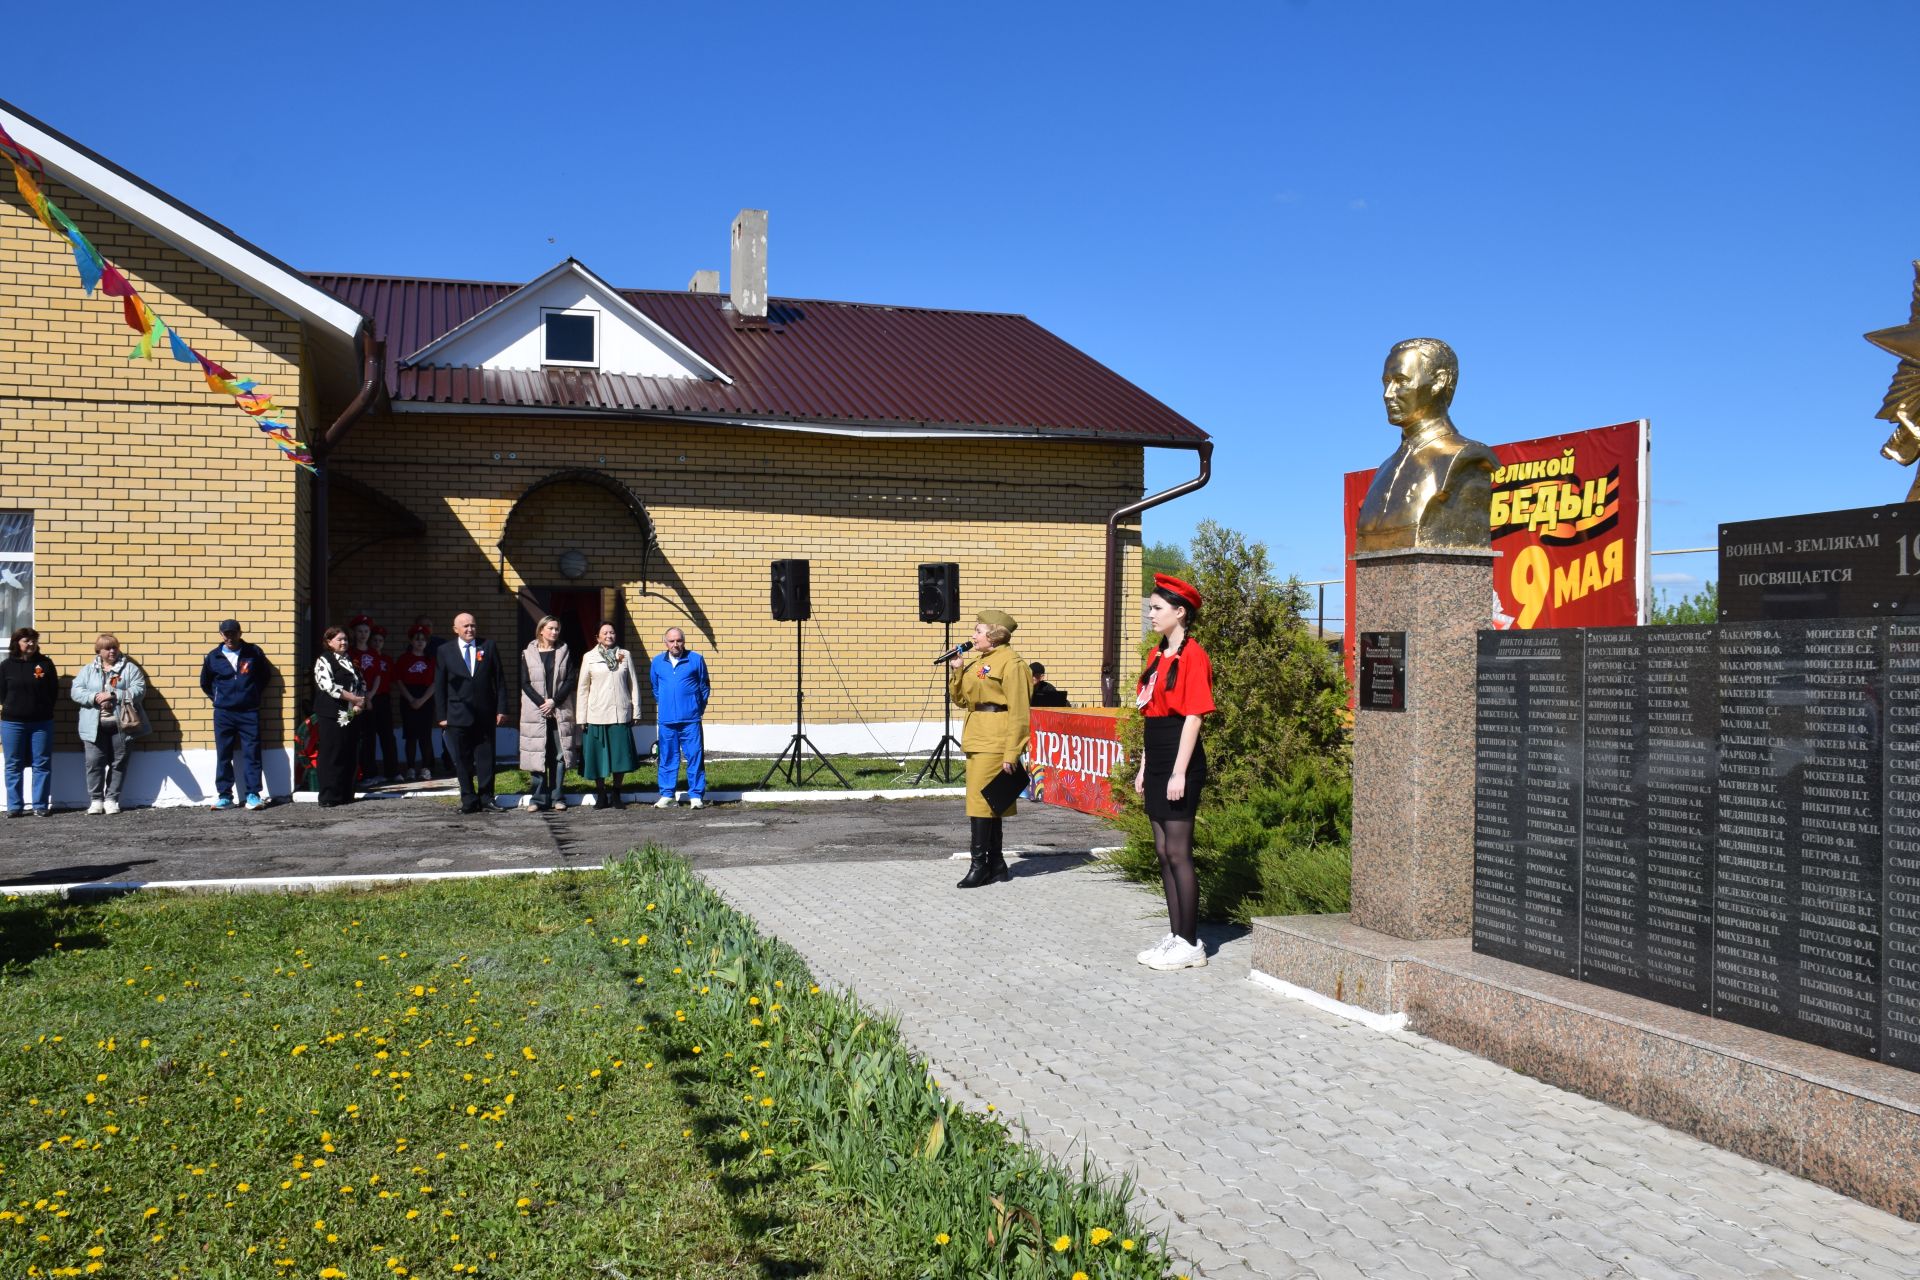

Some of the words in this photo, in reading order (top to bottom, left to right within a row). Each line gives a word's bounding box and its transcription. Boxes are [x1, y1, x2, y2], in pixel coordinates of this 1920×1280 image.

[1491, 448, 1575, 483] еликой
[1490, 477, 1608, 533] БЕДЫ!
[1726, 541, 1784, 557] ВОИНАМ
[1796, 534, 1880, 553] ЗЕМЛЯКАМ
[1510, 545, 1550, 629] 9
[1554, 539, 1623, 609] МАЯ
[1739, 569, 1852, 586] ПОСВЯЩАЕТСЯ
[1720, 631, 1761, 640] МАКАРОВ
[1806, 630, 1854, 638] МОИСЕЕВ
[1720, 646, 1761, 654] МАКАРОВ
[1806, 645, 1853, 653] МОИСЕЕВ
[1856, 645, 1874, 654] С.Е.
[1720, 662, 1761, 670] МАКАРОВ
[1764, 662, 1784, 670] М.М.
[1805, 660, 1853, 669] МОИСЕЕВ
[1649, 674, 1672, 682] КЛЕЕВ
[1720, 676, 1761, 684] МАКАРОВ
[1805, 675, 1846, 684] МОКЕЕВ
[1849, 676, 1867, 684] Г.М.
[1720, 690, 1755, 698] МАКЕЕВ
[1806, 690, 1846, 699] МОКЕЕВ
[1720, 706, 1763, 714] МАЛИКОВ
[1766, 707, 1781, 715] С.Г.
[1805, 706, 1846, 715] МОКЕЕВ
[1649, 726, 1678, 734] КОЗЛОВ
[1720, 720, 1752, 728] МАЛОВ
[1805, 722, 1845, 732] МОКЕЕВ
[1720, 735, 1766, 745] МАЛЫГИН
[1805, 739, 1845, 749] МОКЕЕВ
[1848, 740, 1868, 751] М.В.
[1035, 731, 1124, 783] ПРАЗДНИ
[1720, 750, 1756, 760] МАРКОВ
[1720, 764, 1760, 774] МАТВЕЕВ
[1804, 756, 1845, 766] МОКЕЕВ
[1848, 758, 1868, 769] М.Д.
[1804, 771, 1844, 782] МОКЕЕВ
[1719, 780, 1758, 791] МАТВЕЕВ
[1761, 783, 1777, 793] М.Г.
[1803, 787, 1849, 799] МОШКОВ
[1648, 795, 1687, 806] КУЗНЕЦОВ
[1719, 795, 1767, 807] МЕДЯНЦЕВ
[1769, 801, 1786, 809] А.С.
[1649, 808, 1687, 819] КУЗНЕЦОВ
[1802, 803, 1851, 815] НИКИТИН
[1854, 807, 1872, 817] А.С.
[1719, 810, 1768, 823] МЕДЯНЦЕВ
[1770, 815, 1787, 825] В.Ф.
[1649, 822, 1687, 834] КУЗНЕЦОВ
[1802, 818, 1856, 831] НИКОЛАЕВ
[1719, 824, 1768, 837] МЕДЯНЦЕВ
[1770, 831, 1784, 840] Г.Д.
[1649, 836, 1687, 848] КУЗНЕЦОВ
[1802, 833, 1833, 845] ОРЛОВ
[1527, 848, 1553, 857] ГРОМОВ
[1719, 840, 1768, 853] МЕДЯНЦЕВ
[1586, 850, 1621, 862] КАЗАЧКОВ
[1648, 850, 1687, 863] КУЗНЕЦОВ
[1719, 855, 1767, 869] МЕДЯНЦЕВ
[1802, 849, 1840, 862] ПЕТРОВ
[1527, 863, 1553, 873] ГРОМОВ
[1648, 864, 1687, 877] КУЗНЕЦОВ
[1688, 871, 1703, 879] С.С.
[1802, 865, 1840, 878] ПЕТРОВ
[1586, 877, 1621, 890] КАЗАЧКОВ
[1648, 877, 1687, 890] КУЗНЕЦОВ
[1718, 871, 1769, 887] МЕЛЕКЕСОВ
[1586, 891, 1621, 904] КАЗАЧКОВ
[1717, 886, 1768, 902] МЕЛЕКЕСОВ
[1801, 882, 1856, 897] ПОЛОТЦЕВ
[1858, 890, 1876, 901] Г.А.
[1586, 904, 1620, 918] КАЗАЧКОВ
[1718, 901, 1769, 918] МЕЛЕКЕСОВ
[1802, 897, 1856, 913] ПОЛОТЦЕВ
[1858, 906, 1875, 917] В.Г.
[1585, 918, 1620, 931] КАЗАЧКОВ
[1647, 918, 1680, 930] ЛАЗАРЕВ
[1717, 915, 1760, 930] МИРОНОВ
[1801, 912, 1856, 930] ПОЛУЯНОВ
[1584, 931, 1620, 945] КАЗАЧКОВ
[1717, 930, 1753, 944] МИХЕЕВ
[1800, 929, 1852, 947] ПРОТАСОВ
[1584, 945, 1619, 959] КАЗАЧКОВ
[1648, 946, 1681, 959] МАКАРОВ
[1717, 945, 1759, 961] МОИСЕЕВ
[1800, 944, 1852, 962] ПРОТАСОВ
[1648, 959, 1681, 973] МАКАРОВ
[1717, 961, 1760, 977] МОИСЕЕВ
[1762, 971, 1779, 982] В.Ф.
[1800, 961, 1853, 979] ПРОТАСОВ
[1648, 973, 1681, 987] МАКАРОВ
[1717, 976, 1759, 993] МОИСЕЕВ
[1800, 977, 1853, 996] ПЫЖИКОВ
[1717, 991, 1760, 1008] МОИСЕЕВ
[1800, 994, 1853, 1014] ПЫЖИКОВ
[1855, 1007, 1872, 1020] Г.Д.
[1799, 1010, 1851, 1031] ПЫЖИКОВ
[1853, 1024, 1874, 1038] М.Д.
